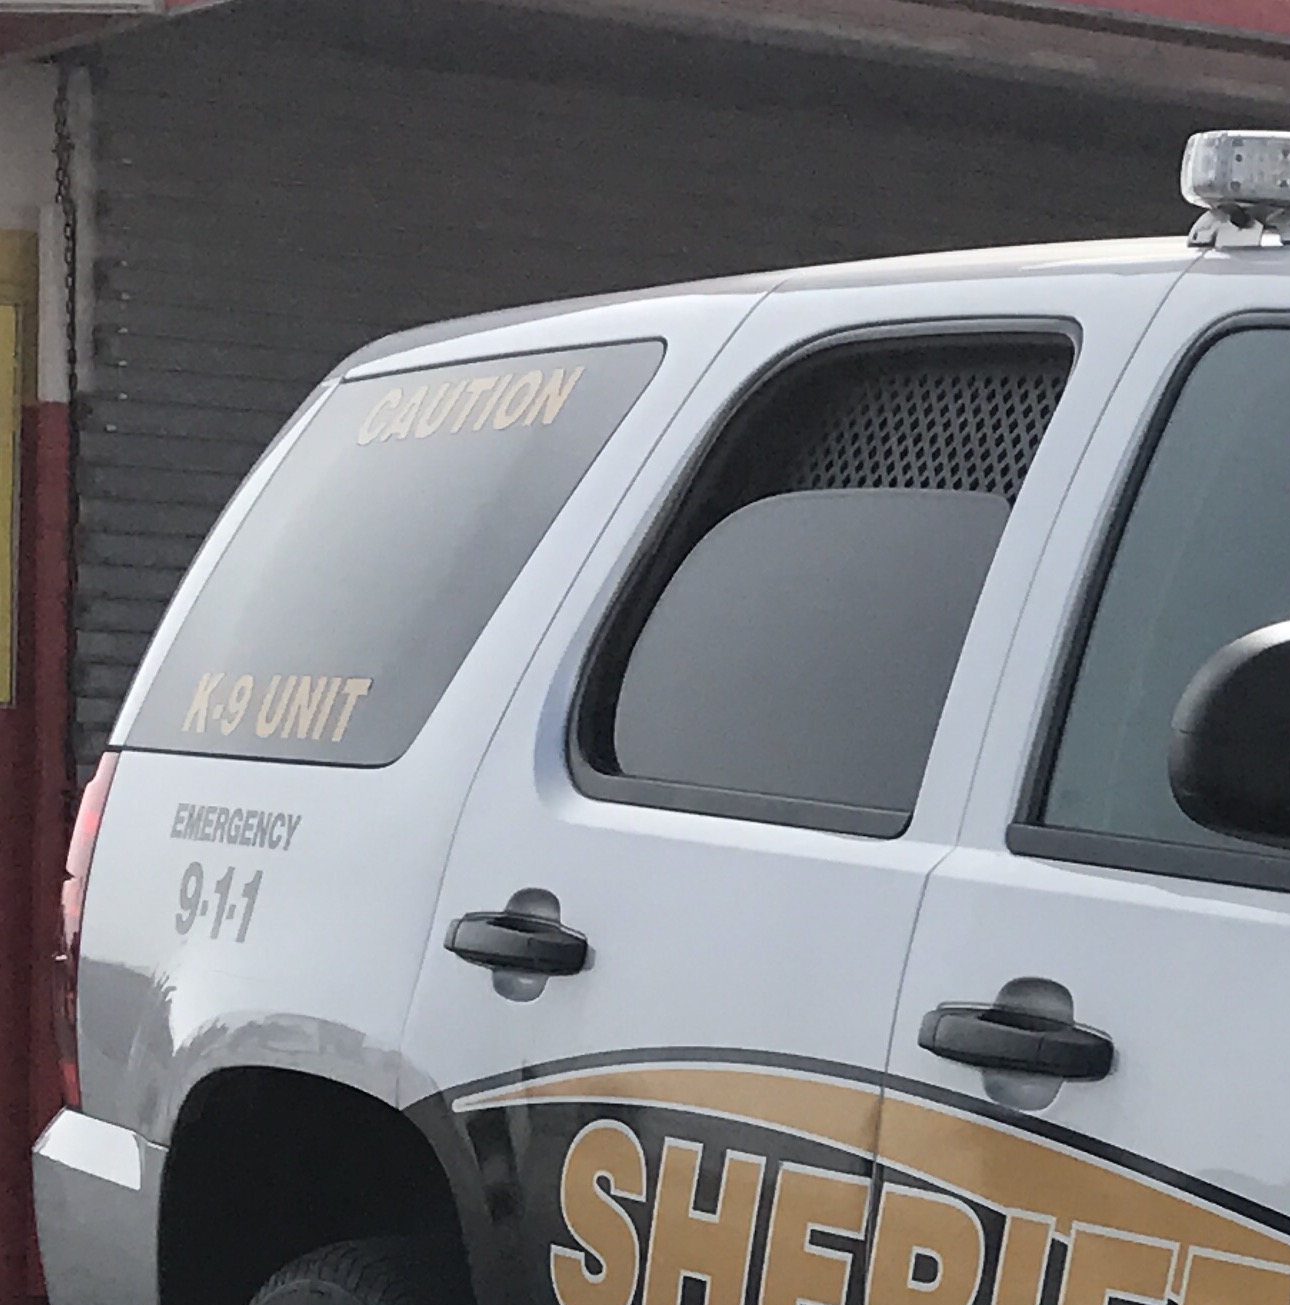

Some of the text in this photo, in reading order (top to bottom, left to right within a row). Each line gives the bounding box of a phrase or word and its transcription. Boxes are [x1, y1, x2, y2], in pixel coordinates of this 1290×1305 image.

[356, 366, 585, 447] CAUTION
[181, 672, 374, 743] K-9 UNIT
[170, 803, 302, 851] EMERGENCY
[175, 861, 263, 943] 9-1-1
